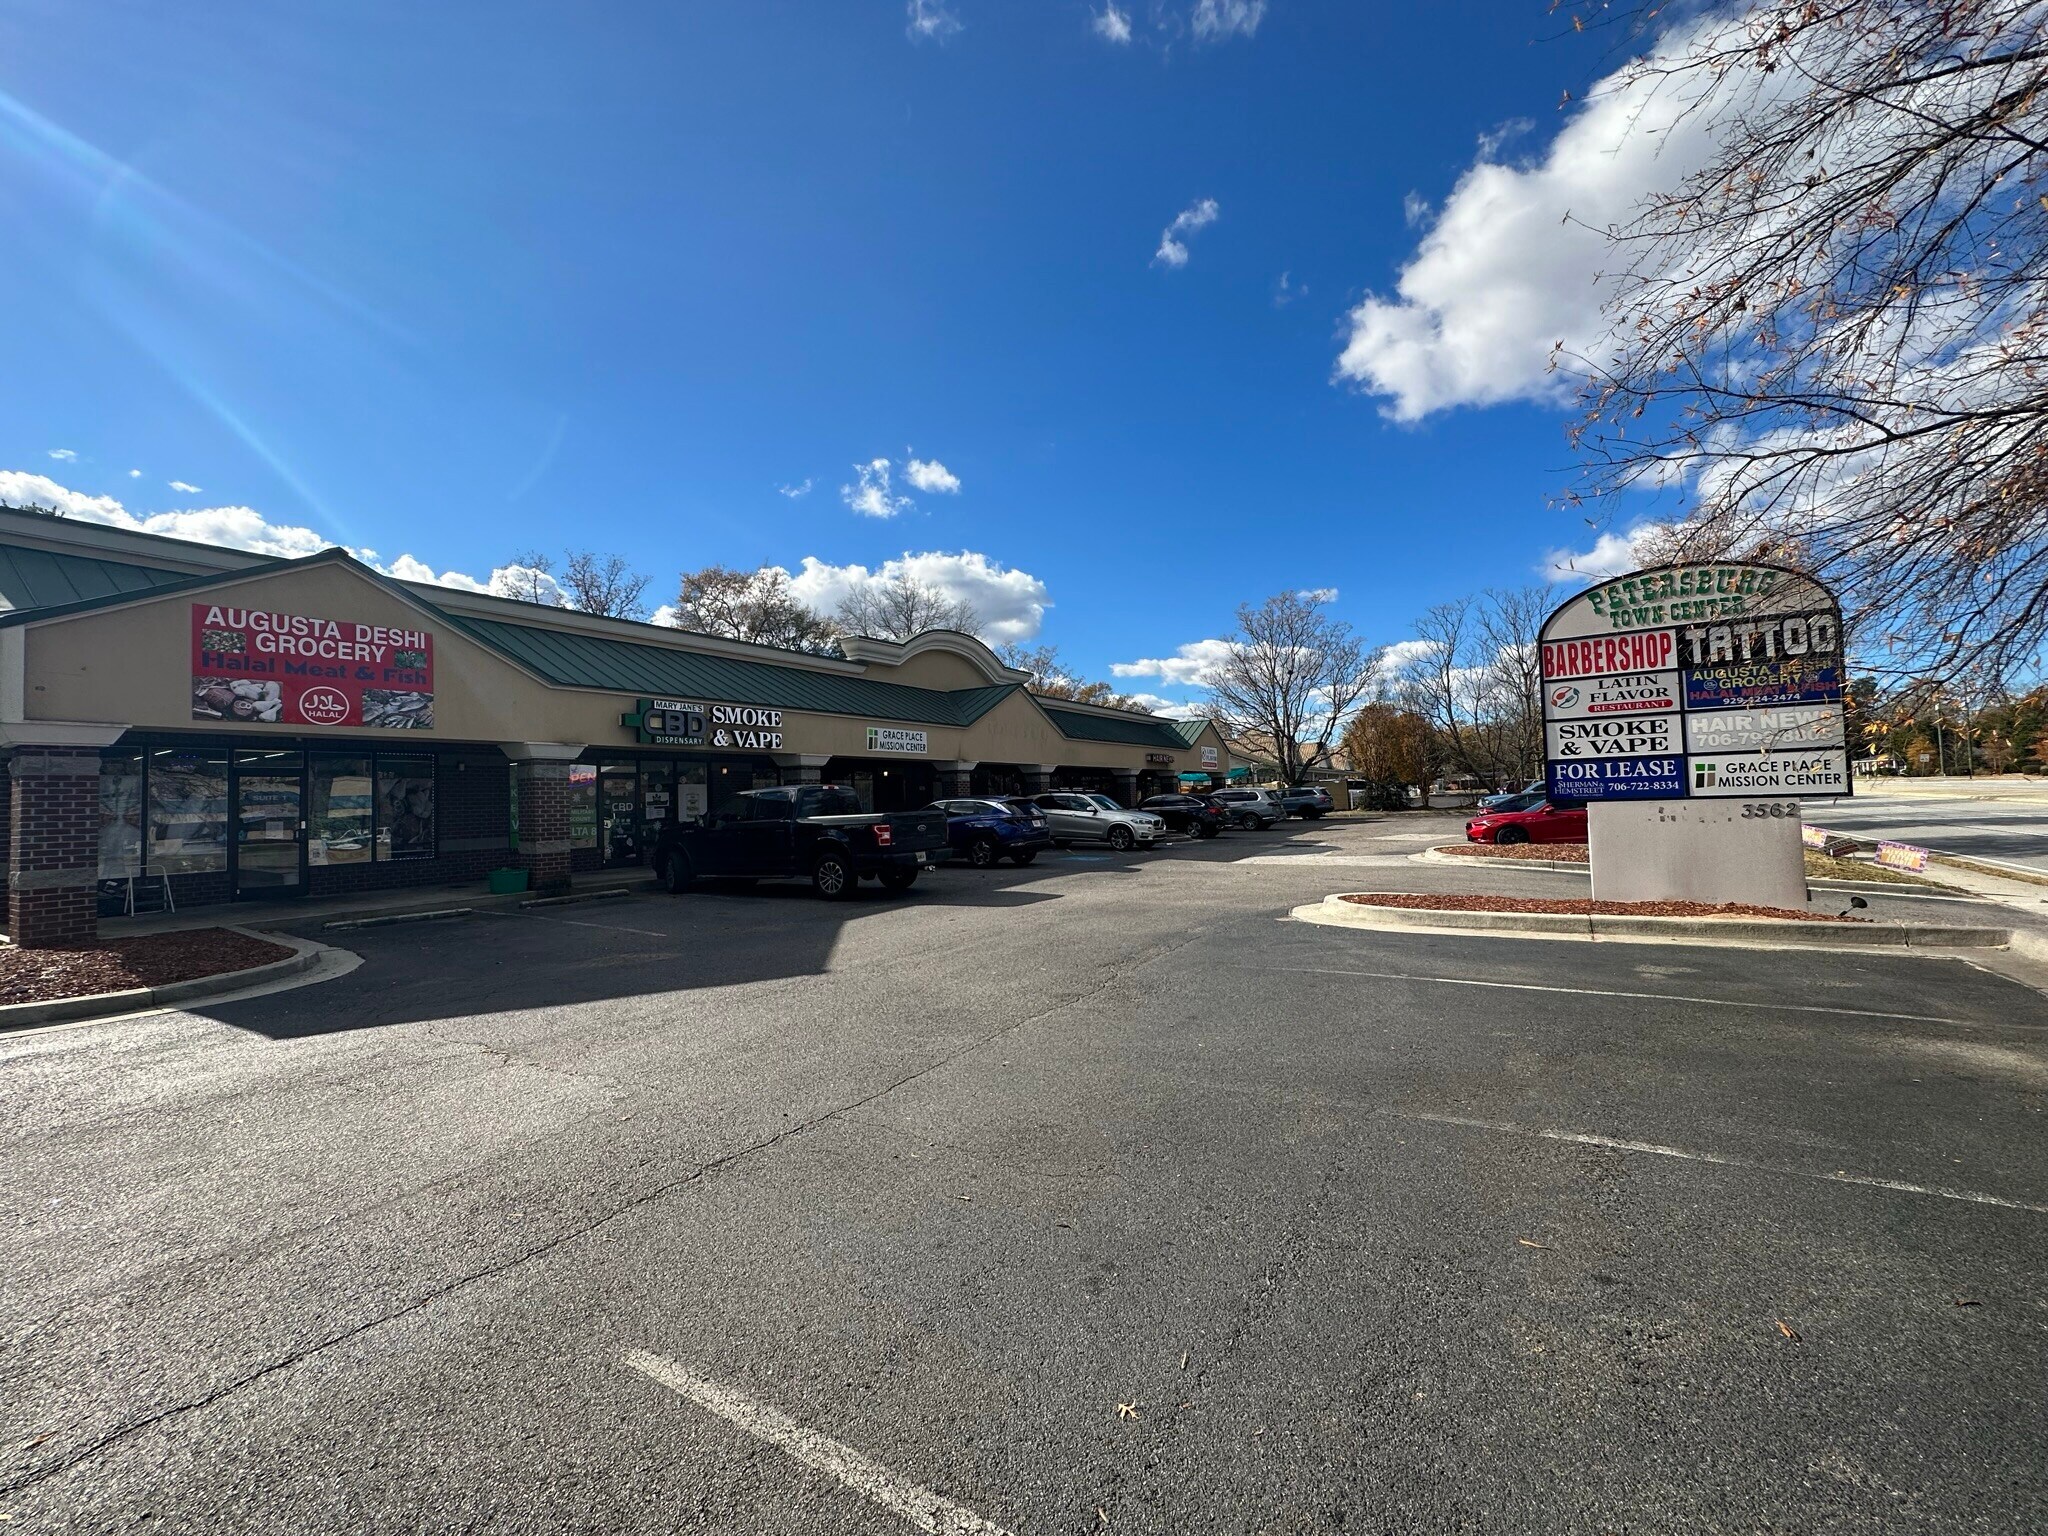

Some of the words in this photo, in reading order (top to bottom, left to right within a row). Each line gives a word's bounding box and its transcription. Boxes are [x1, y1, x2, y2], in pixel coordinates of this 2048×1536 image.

[1587, 569, 1777, 615] PETERSBURG
[1609, 605, 1664, 628] TOWN
[1670, 595, 1746, 620] CENTER
[204, 606, 341, 640] AUGUSTA
[354, 624, 425, 649] DESHI
[1685, 614, 1836, 664] TATTOO
[255, 632, 386, 663] GROCERY
[1543, 632, 1672, 678] BARBERSHOP
[202, 651, 275, 673] Halal
[285, 660, 346, 680] Meat
[355, 665, 376, 681] &
[383, 668, 427, 685] Fish
[1693, 666, 1770, 681] AUGUSTA
[1598, 674, 1659, 690] LATIN
[1719, 673, 1802, 689] GROCERY
[304, 694, 345, 711] حلال
[1590, 687, 1669, 703] FLAVOR
[1689, 690, 1733, 700] HALAL
[656, 701, 678, 712] MARY
[680, 704, 704, 713] JANE'S
[1594, 700, 1667, 712] RESTAURANT
[644, 709, 706, 737] CBD
[712, 705, 783, 727] SMOKE
[1690, 716, 1753, 733] HAIR
[1759, 709, 1837, 729] NEWS
[882, 730, 905, 741] GRACE
[905, 733, 924, 742] PLACE
[1559, 719, 1669, 740] SMOKE
[656, 735, 703, 745] DISPENSARY
[713, 728, 730, 747] &
[733, 731, 783, 749] VAPE
[879, 740, 905, 751] MISSION
[905, 743, 927, 752] CENTER
[1560, 741, 1582, 756] &
[1588, 737, 1669, 754] VAPE
[1555, 764, 1600, 779] FOR
[1604, 760, 1677, 778] LEASE
[1726, 761, 1778, 774] GRACE
[1783, 759, 1831, 773] PLACE
[569, 772, 597, 784] PEN
[1557, 780, 1599, 788] SHERMAN
[1718, 775, 1779, 787] MISSION
[1784, 773, 1841, 786] CENTER
[1554, 786, 1603, 795] HEMSTREET
[1608, 781, 1679, 793] 706-722-8334
[611, 802, 634, 811] CBD
[1741, 803, 1798, 818] 3562
[571, 827, 589, 836] LTA
